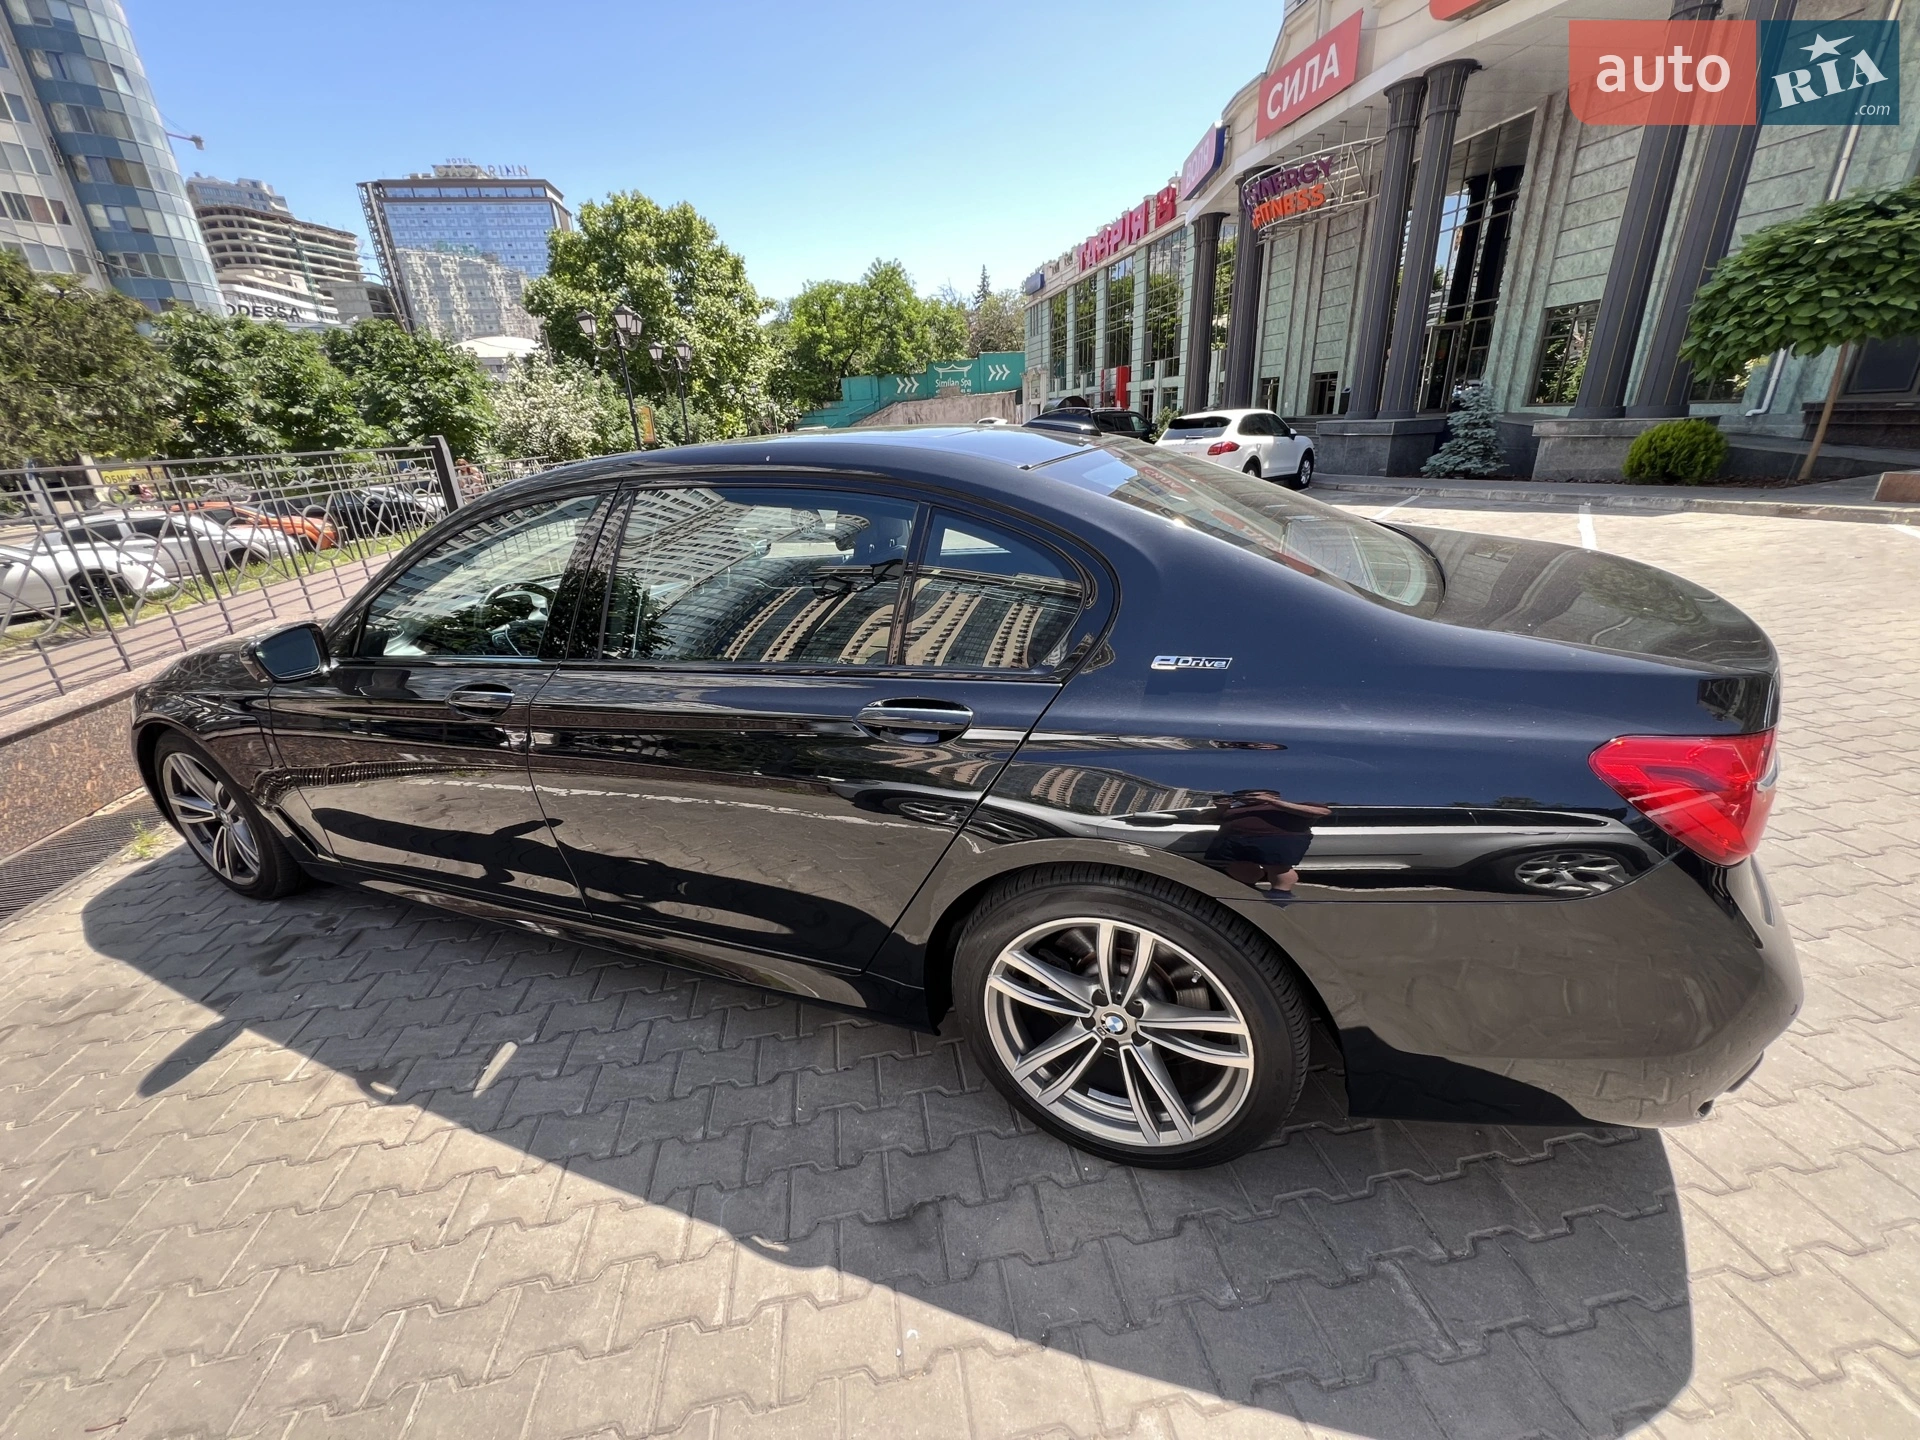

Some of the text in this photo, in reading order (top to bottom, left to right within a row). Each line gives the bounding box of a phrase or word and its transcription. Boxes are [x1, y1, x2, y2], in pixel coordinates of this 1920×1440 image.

[1266, 42, 1340, 120] СИЛА
[1076, 199, 1150, 272] ТАВРІЯ
[1251, 183, 1327, 230] FITNESS
[935, 377, 972, 388] Similan Spa
